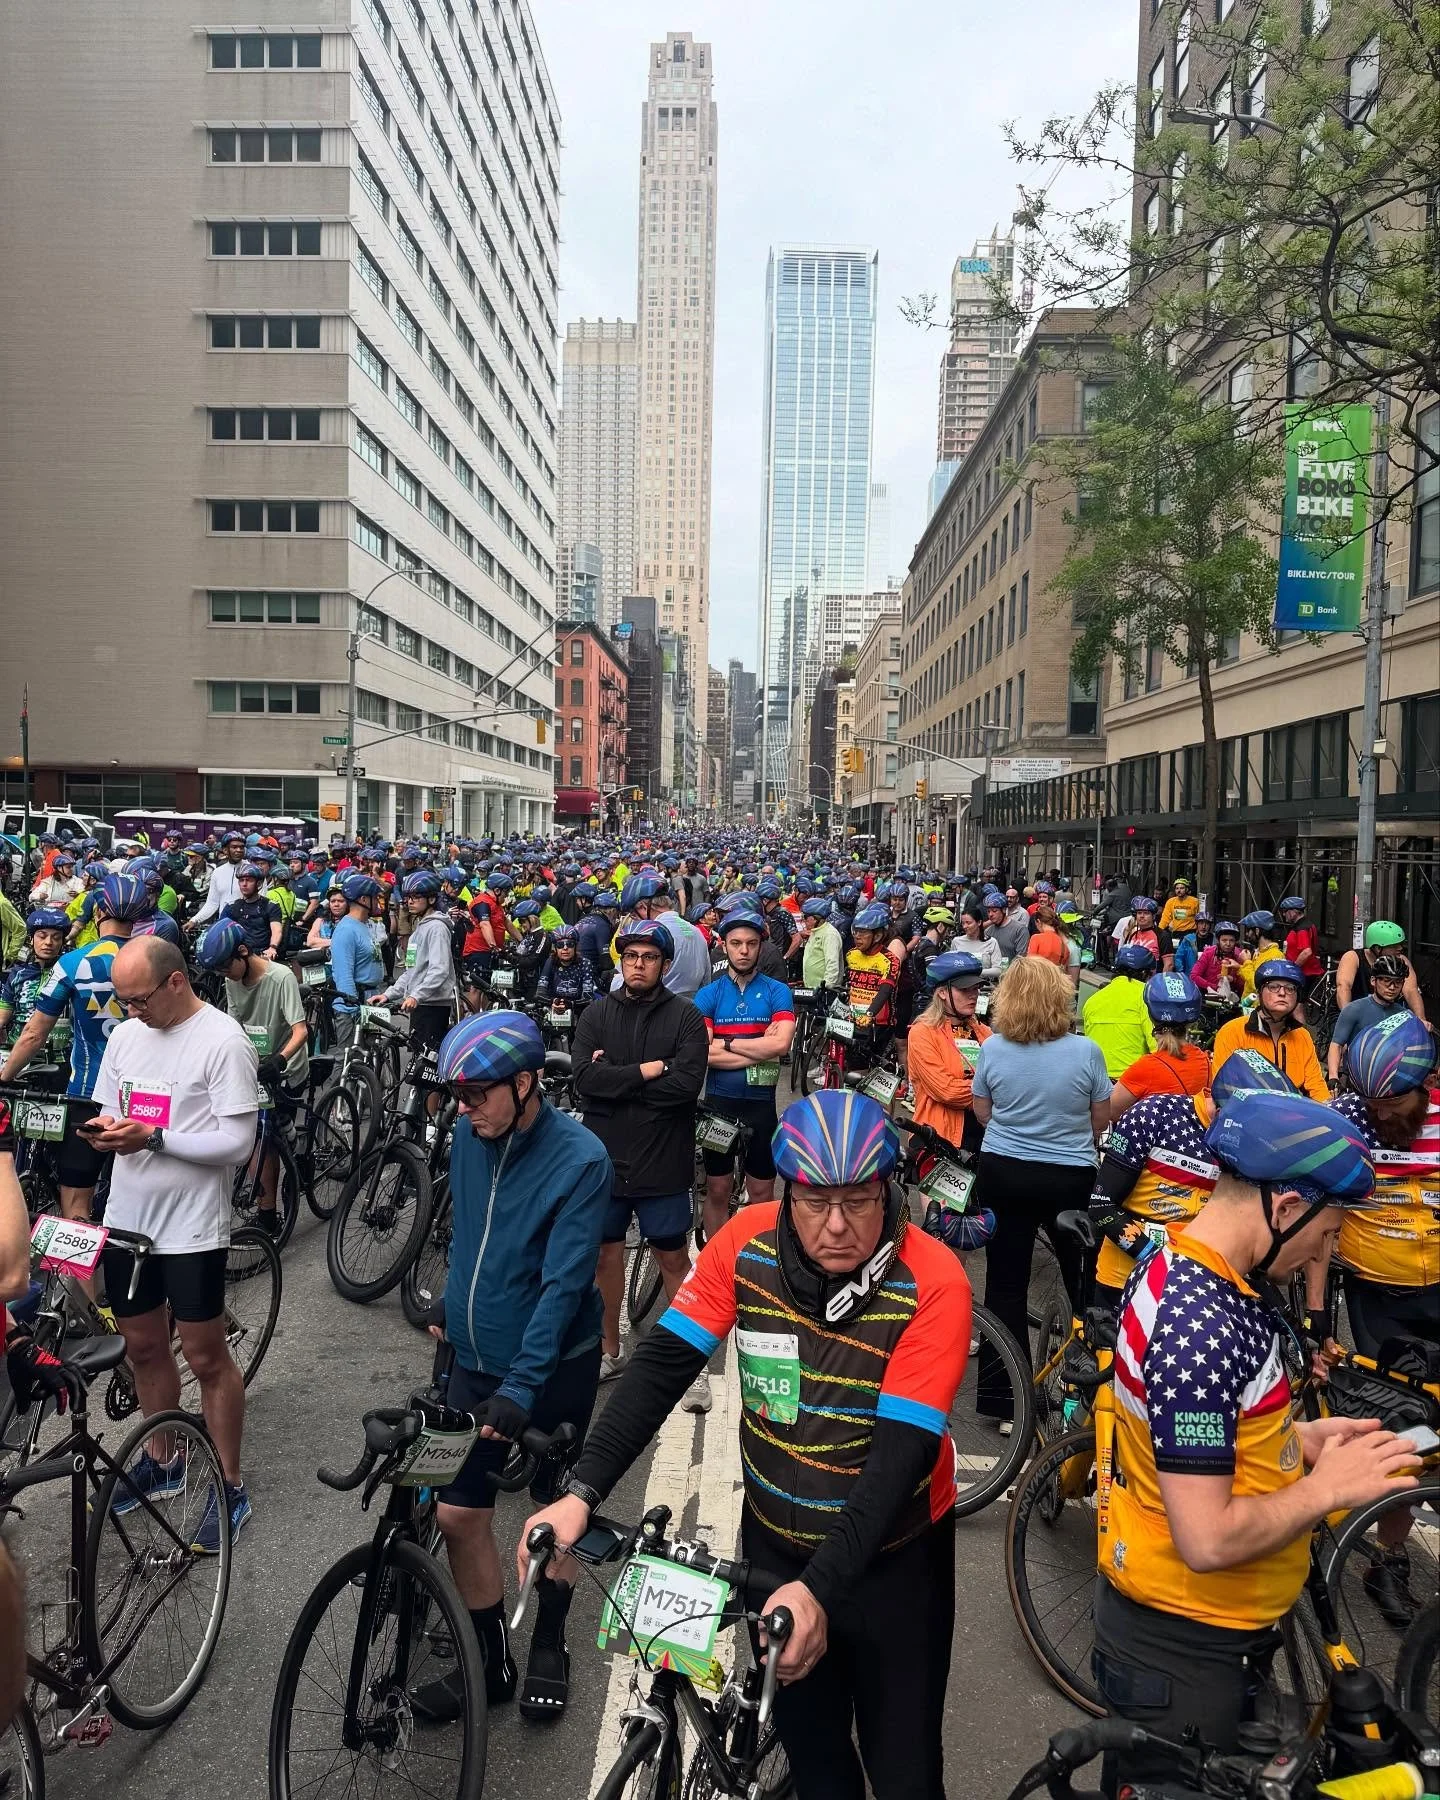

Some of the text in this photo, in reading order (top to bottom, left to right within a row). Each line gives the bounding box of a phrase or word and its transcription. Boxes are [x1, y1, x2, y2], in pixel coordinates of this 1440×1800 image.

[1312, 420, 1343, 432] NYC
[1298, 459, 1356, 480] FIVE
[1298, 477, 1356, 497] BORO
[1297, 496, 1354, 516] BIKE
[1287, 569, 1356, 581] BIKE.NYC/TOUR
[1300, 604, 1338, 614] TD Bank
[421, 1071, 448, 1084] BIKIN
[875, 1075, 893, 1090] P5261
[30, 1111, 61, 1123] M7179
[131, 1103, 164, 1118] 25887
[941, 1171, 967, 1192] P5260
[55, 1232, 97, 1252] 25887
[825, 1241, 895, 1322] EVS
[741, 1366, 791, 1396] M7518
[1175, 1412, 1224, 1424] KINDER
[1175, 1424, 1225, 1438] KREBS
[1176, 1438, 1225, 1447] STIFTUNG
[421, 1445, 467, 1460] M7646
[619, 1565, 635, 1596] BORO
[628, 1566, 641, 1598] TOUR
[643, 1585, 713, 1620] M7517
